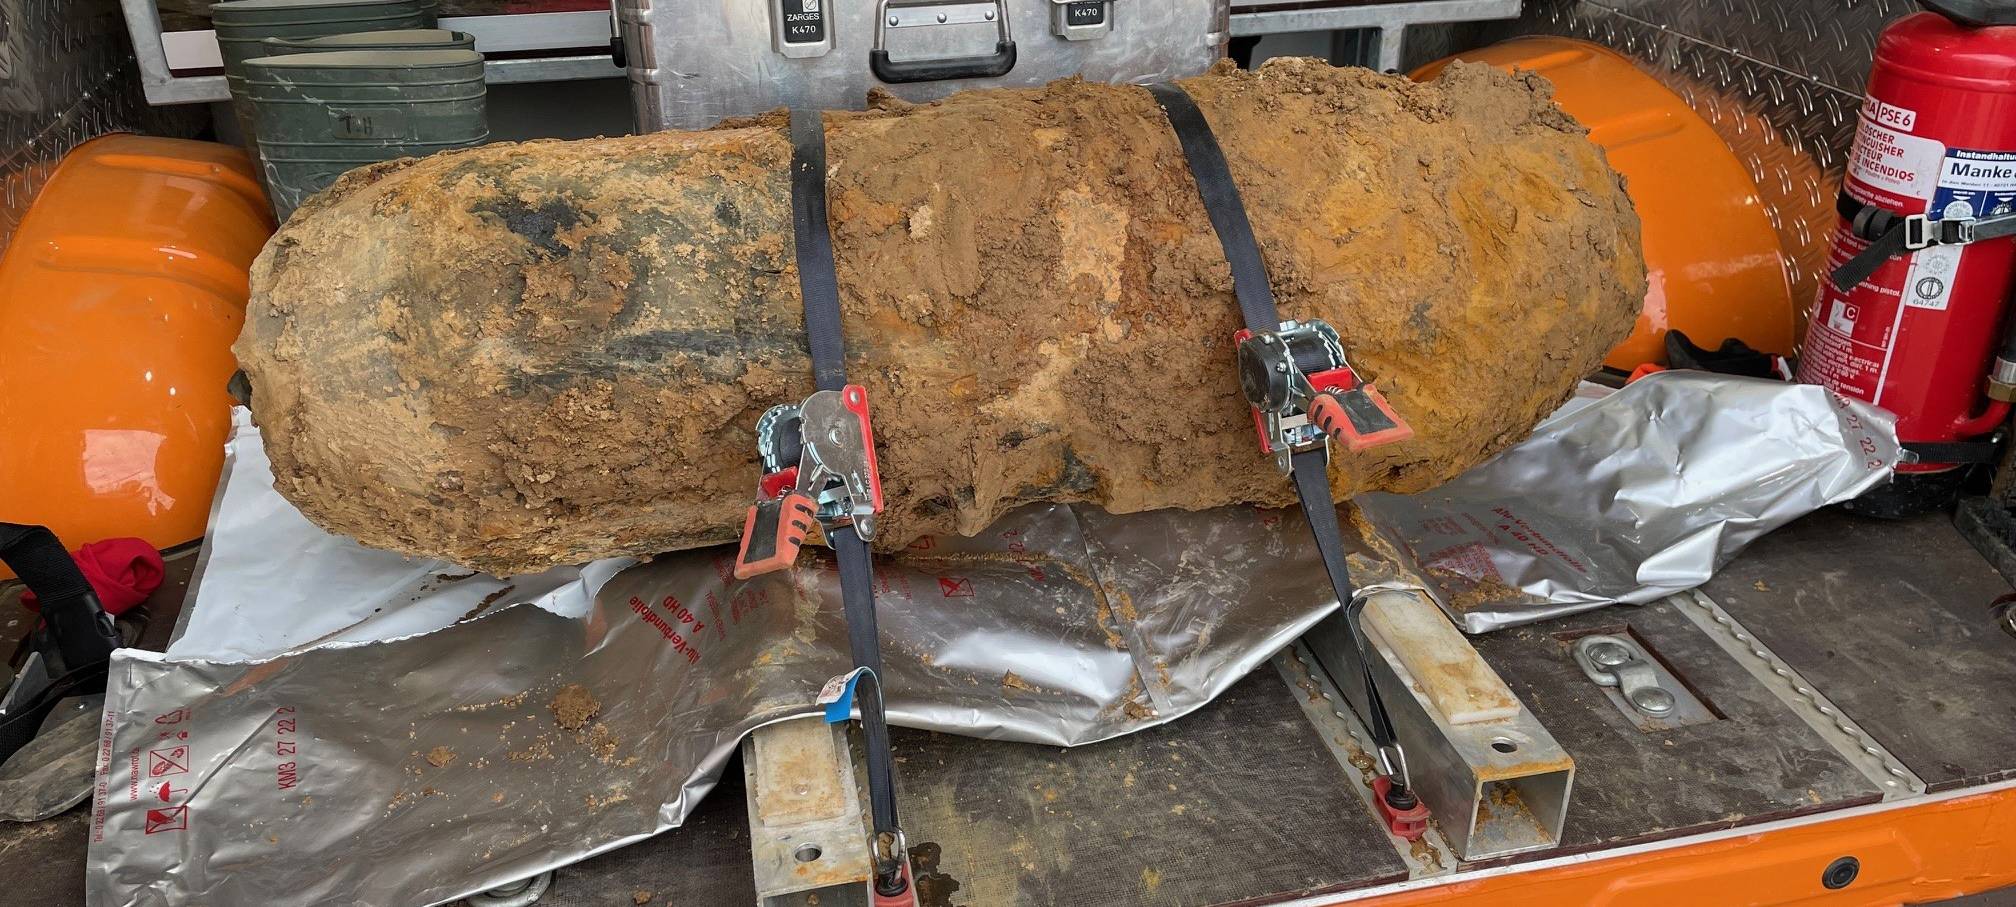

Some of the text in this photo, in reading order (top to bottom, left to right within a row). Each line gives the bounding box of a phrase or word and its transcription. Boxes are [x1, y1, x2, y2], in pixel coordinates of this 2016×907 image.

[786, 13, 820, 22] ZARGES
[1880, 106, 1911, 127] PSE 6
[1861, 157, 1915, 182] INCENDIOS
[1951, 162, 2012, 179] Manke
[1860, 437, 1876, 455] 22
[1867, 459, 1882, 469] 2
[662, 595, 705, 634] A 40 HD
[276, 706, 296, 790] KM3 27 22 2
